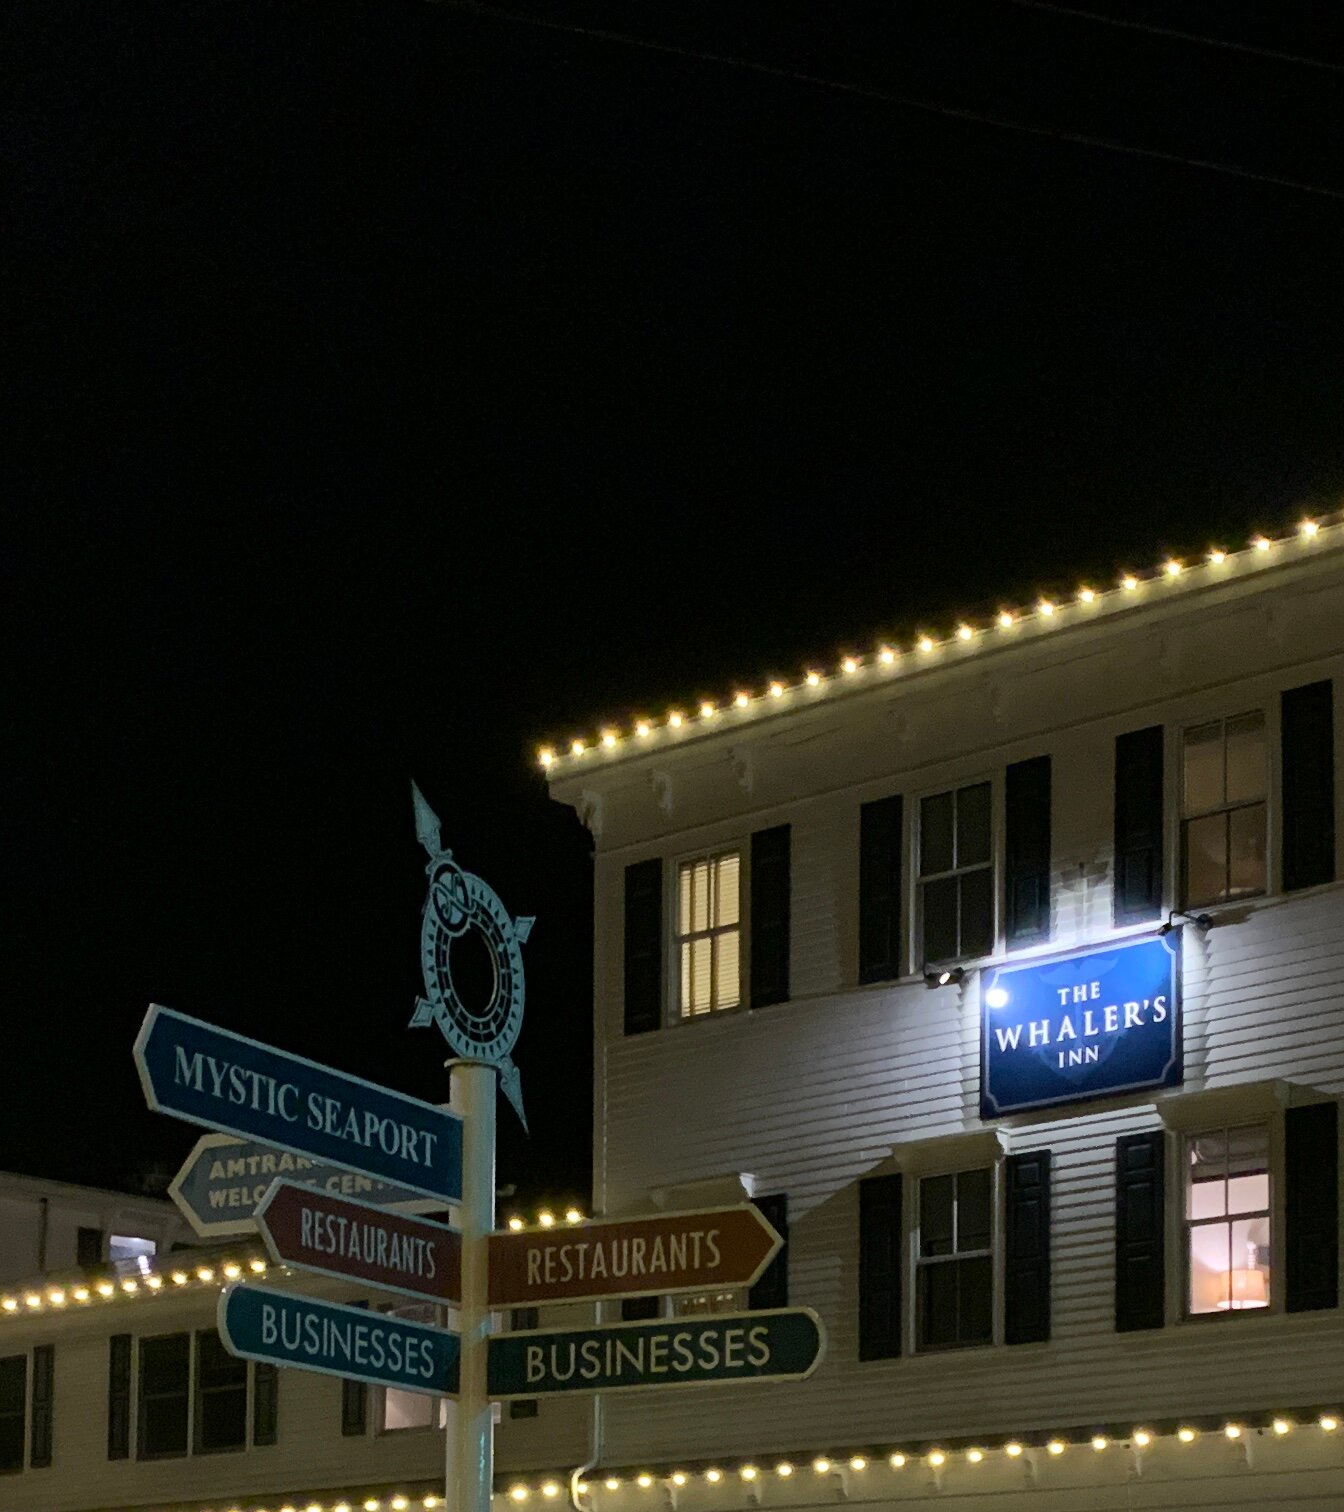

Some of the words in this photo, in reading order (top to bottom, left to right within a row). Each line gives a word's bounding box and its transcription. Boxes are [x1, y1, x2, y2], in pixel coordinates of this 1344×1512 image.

[1057, 981, 1101, 1006] THE
[995, 995, 1167, 1053] WHALER'S
[1058, 1044, 1100, 1069] INN
[174, 1044, 299, 1123] MYSTIC
[306, 1091, 438, 1169] SEAPORT
[299, 1207, 437, 1280] RESTAURANTS
[527, 1229, 721, 1286] RESTAURANTS
[260, 1303, 435, 1379] BUSINESSES
[526, 1326, 771, 1383] BUSINESSES
